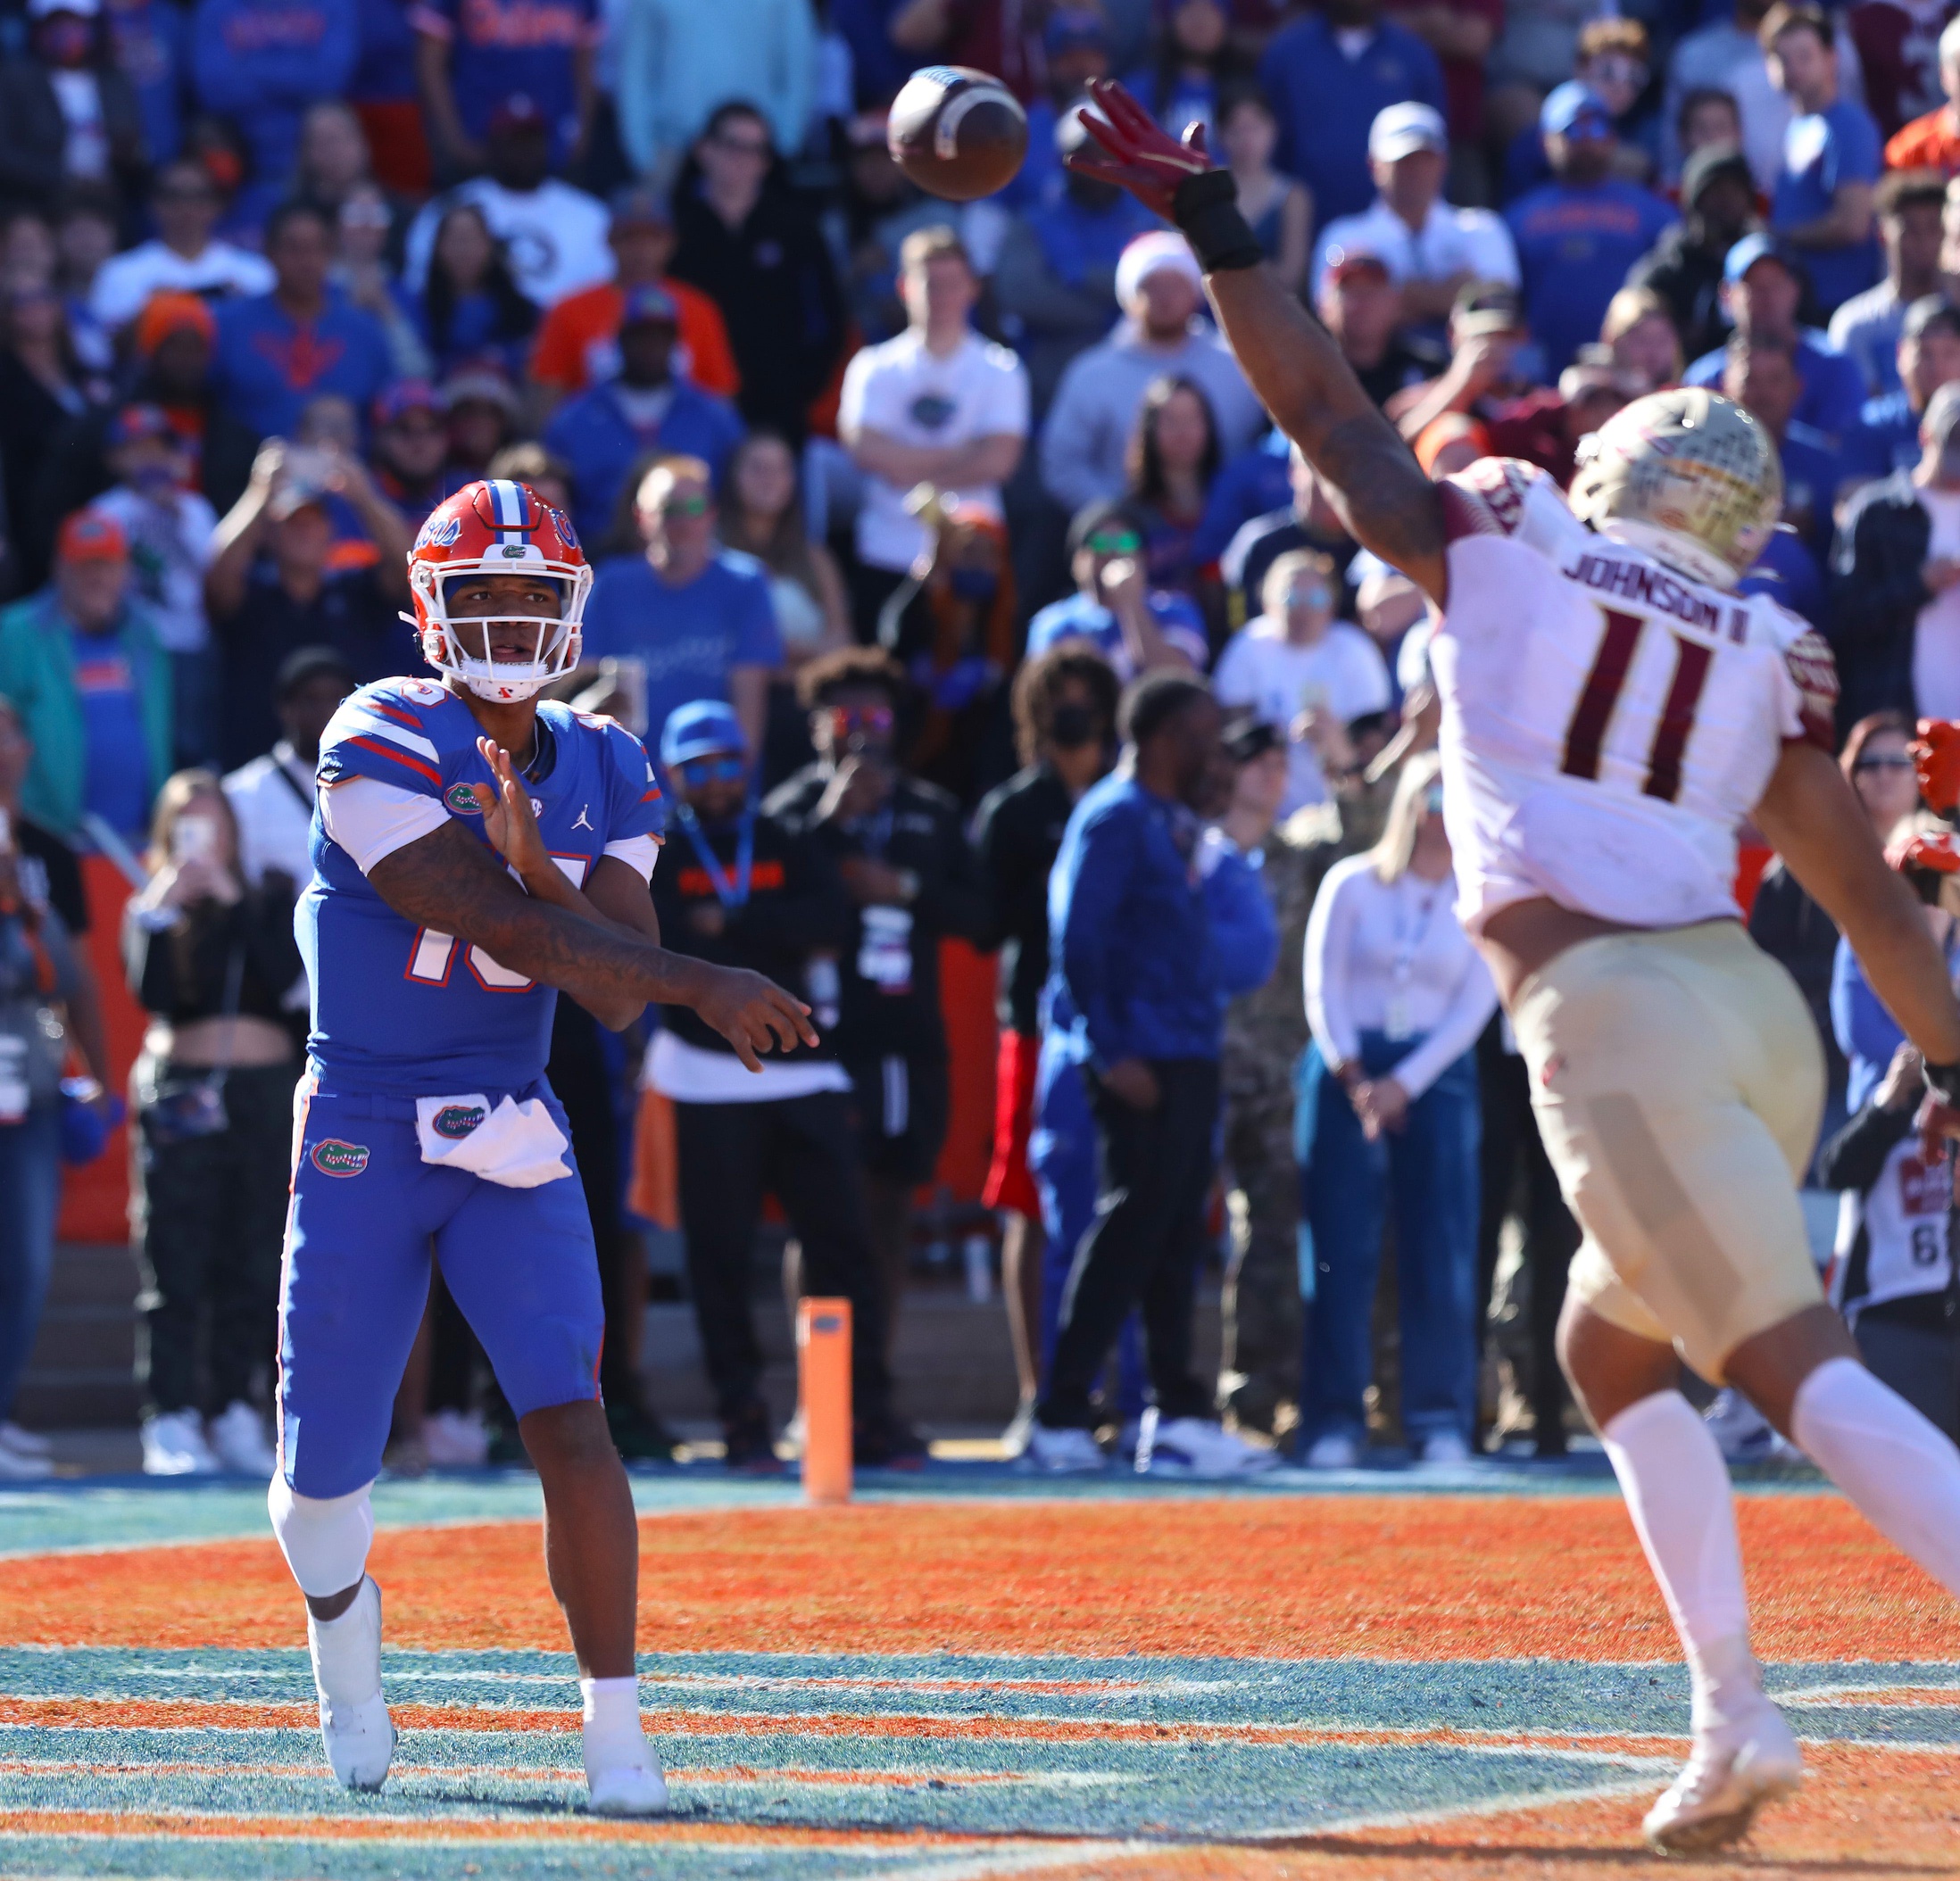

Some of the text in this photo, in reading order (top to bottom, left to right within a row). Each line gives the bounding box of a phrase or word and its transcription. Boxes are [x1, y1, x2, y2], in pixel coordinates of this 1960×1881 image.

[1563, 554, 1721, 634] JOHNSON
[1728, 608, 1750, 645] II
[1559, 600, 1716, 803] 11
